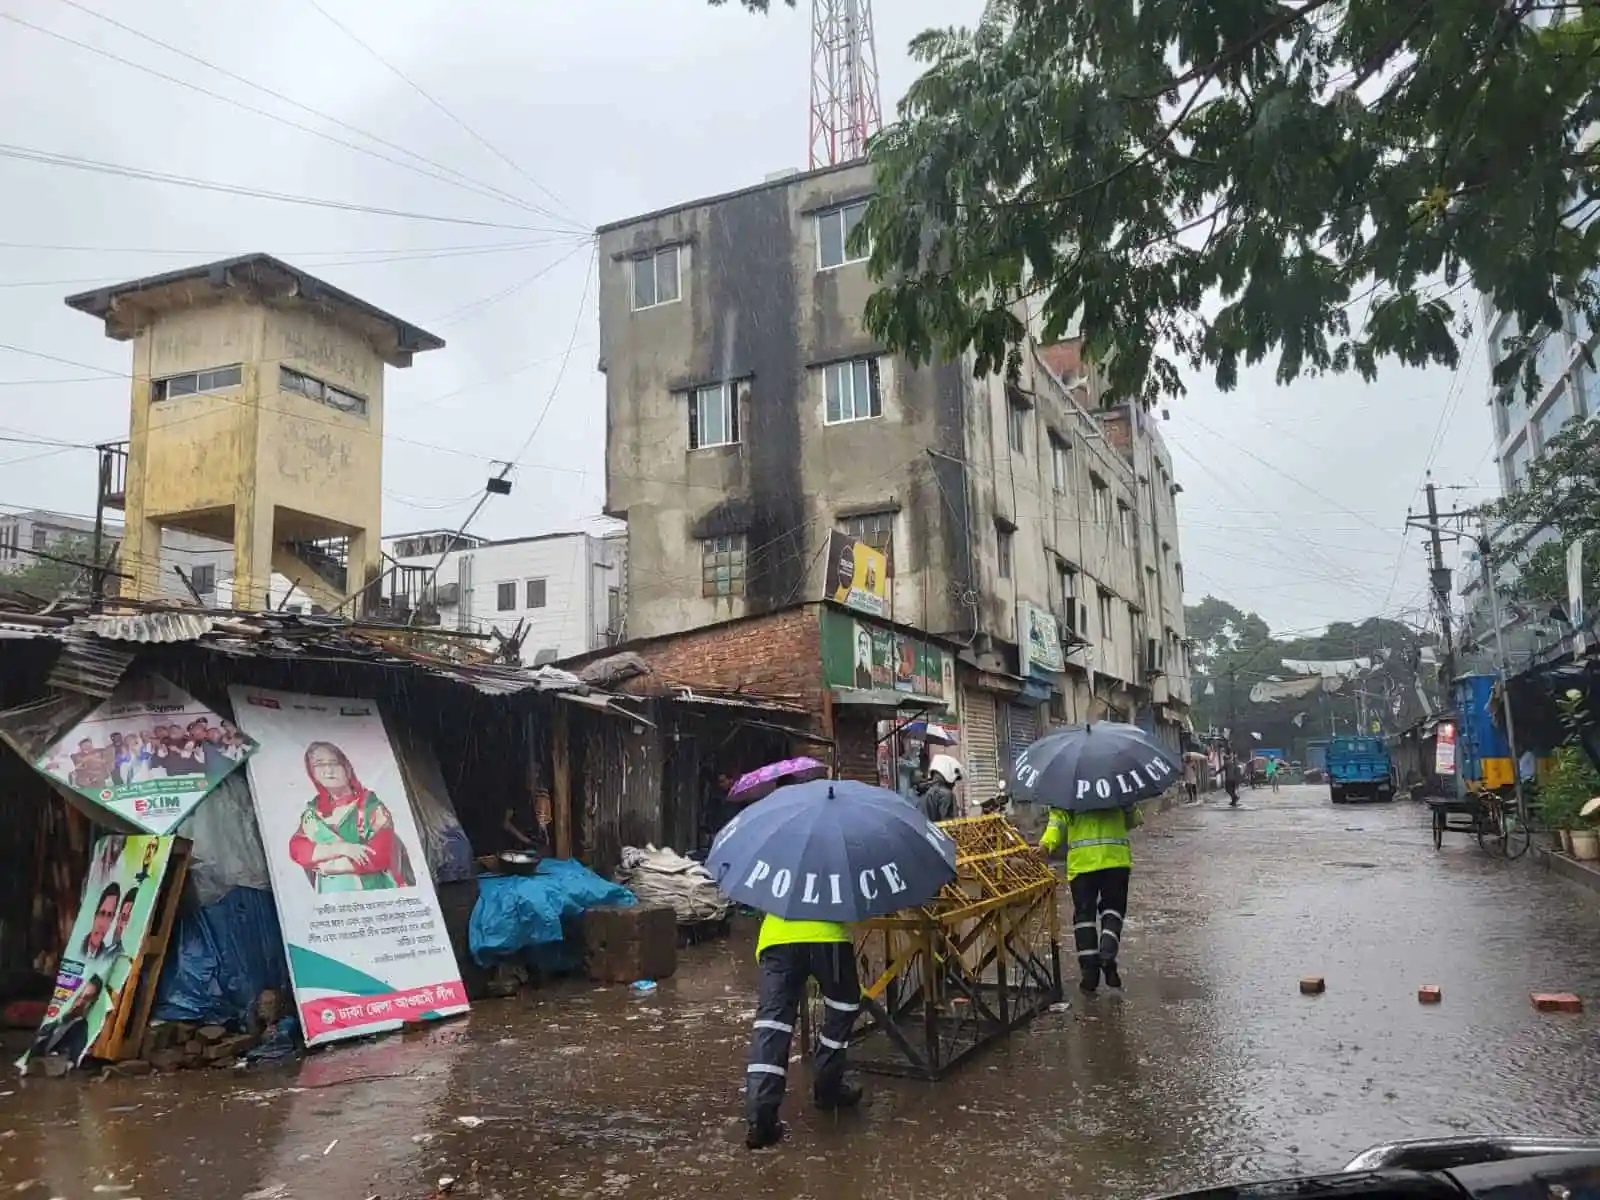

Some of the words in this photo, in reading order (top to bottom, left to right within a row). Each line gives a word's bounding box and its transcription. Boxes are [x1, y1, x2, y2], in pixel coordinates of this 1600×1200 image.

[1076, 756, 1170, 799] POLICE
[135, 796, 180, 811] EXIM
[744, 860, 908, 904] POLICE
[339, 1007, 363, 1020] ঢাকা
[366, 999, 392, 1016] জেলা
